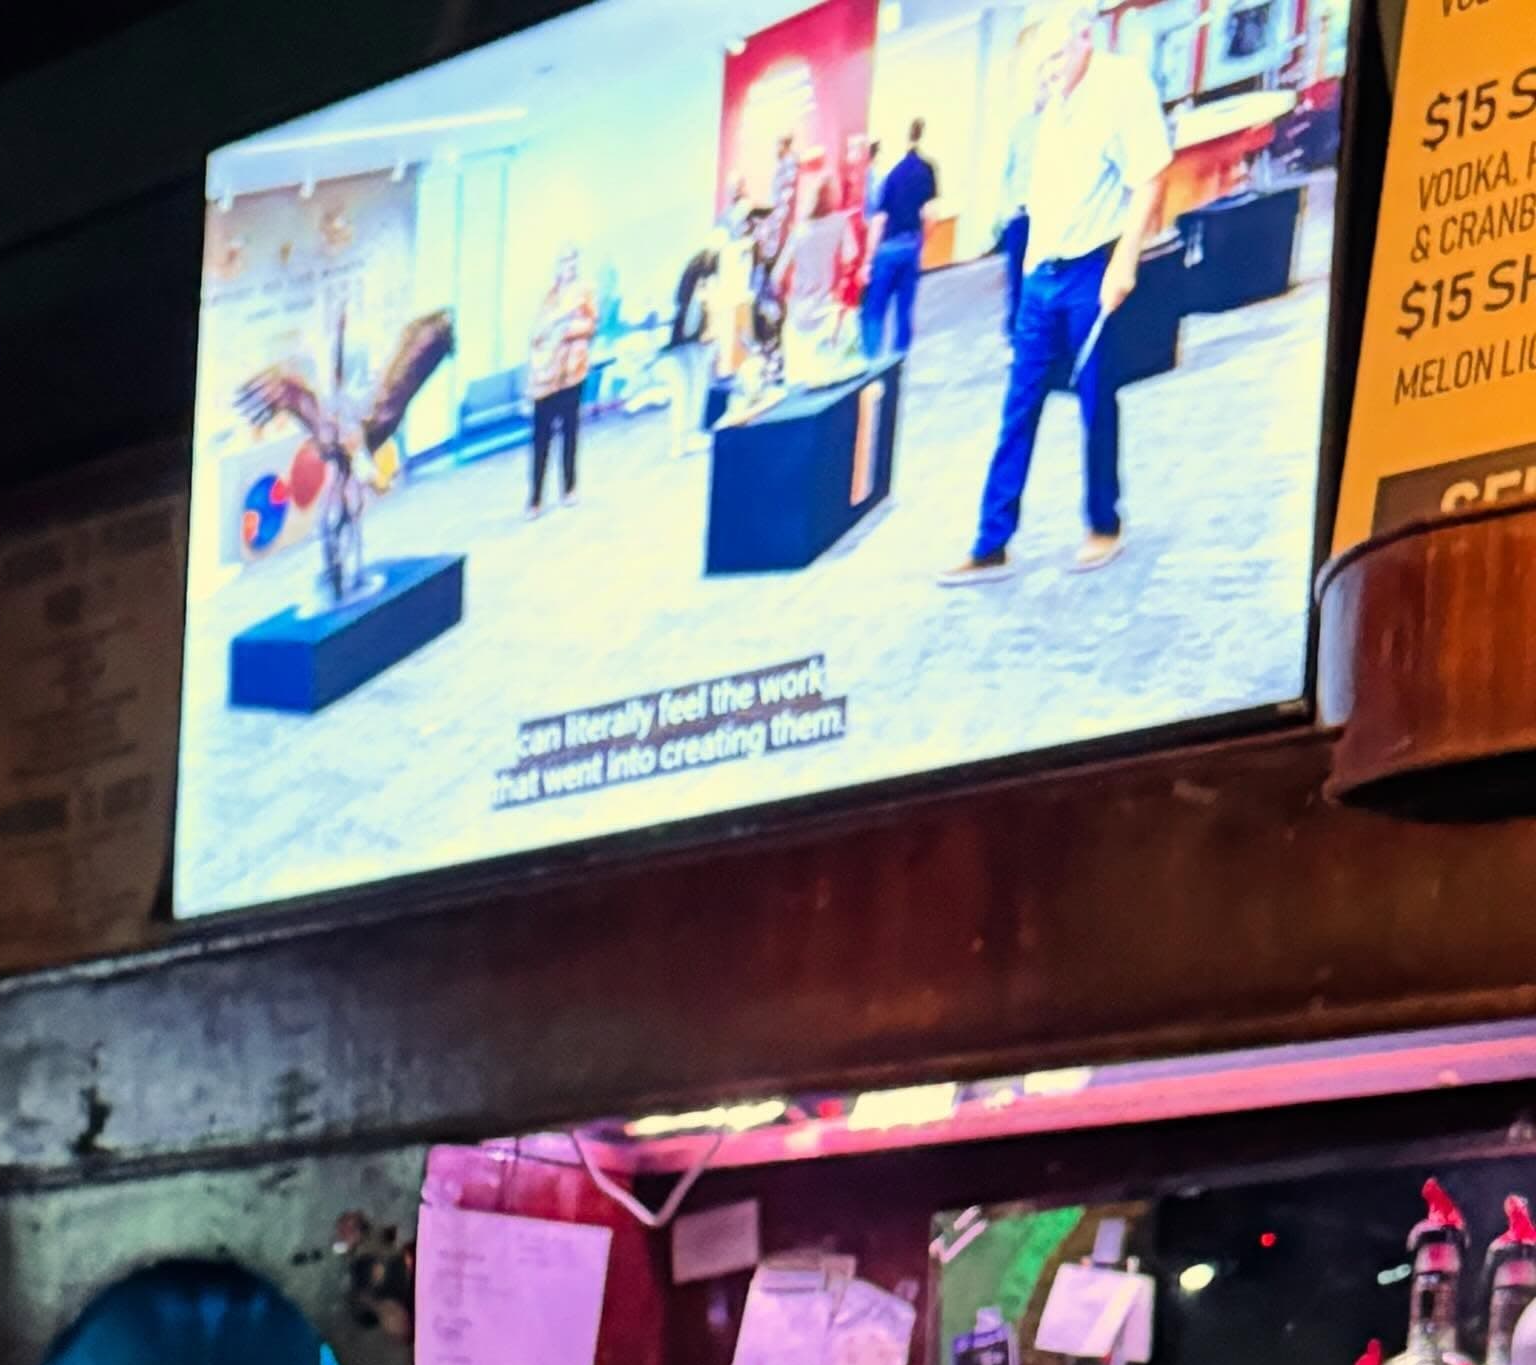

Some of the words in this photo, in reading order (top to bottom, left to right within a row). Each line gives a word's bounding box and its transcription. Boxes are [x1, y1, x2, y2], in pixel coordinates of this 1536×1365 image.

[1421, 79, 1499, 151] $15
[1410, 224, 1431, 264] &
[1395, 270, 1475, 340] $15
[1394, 344, 1495, 406] MELON
[565, 700, 657, 748] literally
[658, 684, 709, 728] feel
[712, 679, 756, 716] the
[759, 660, 824, 705] work
[543, 750, 605, 795] went
[606, 743, 658, 781] into
[659, 718, 768, 771] creating
